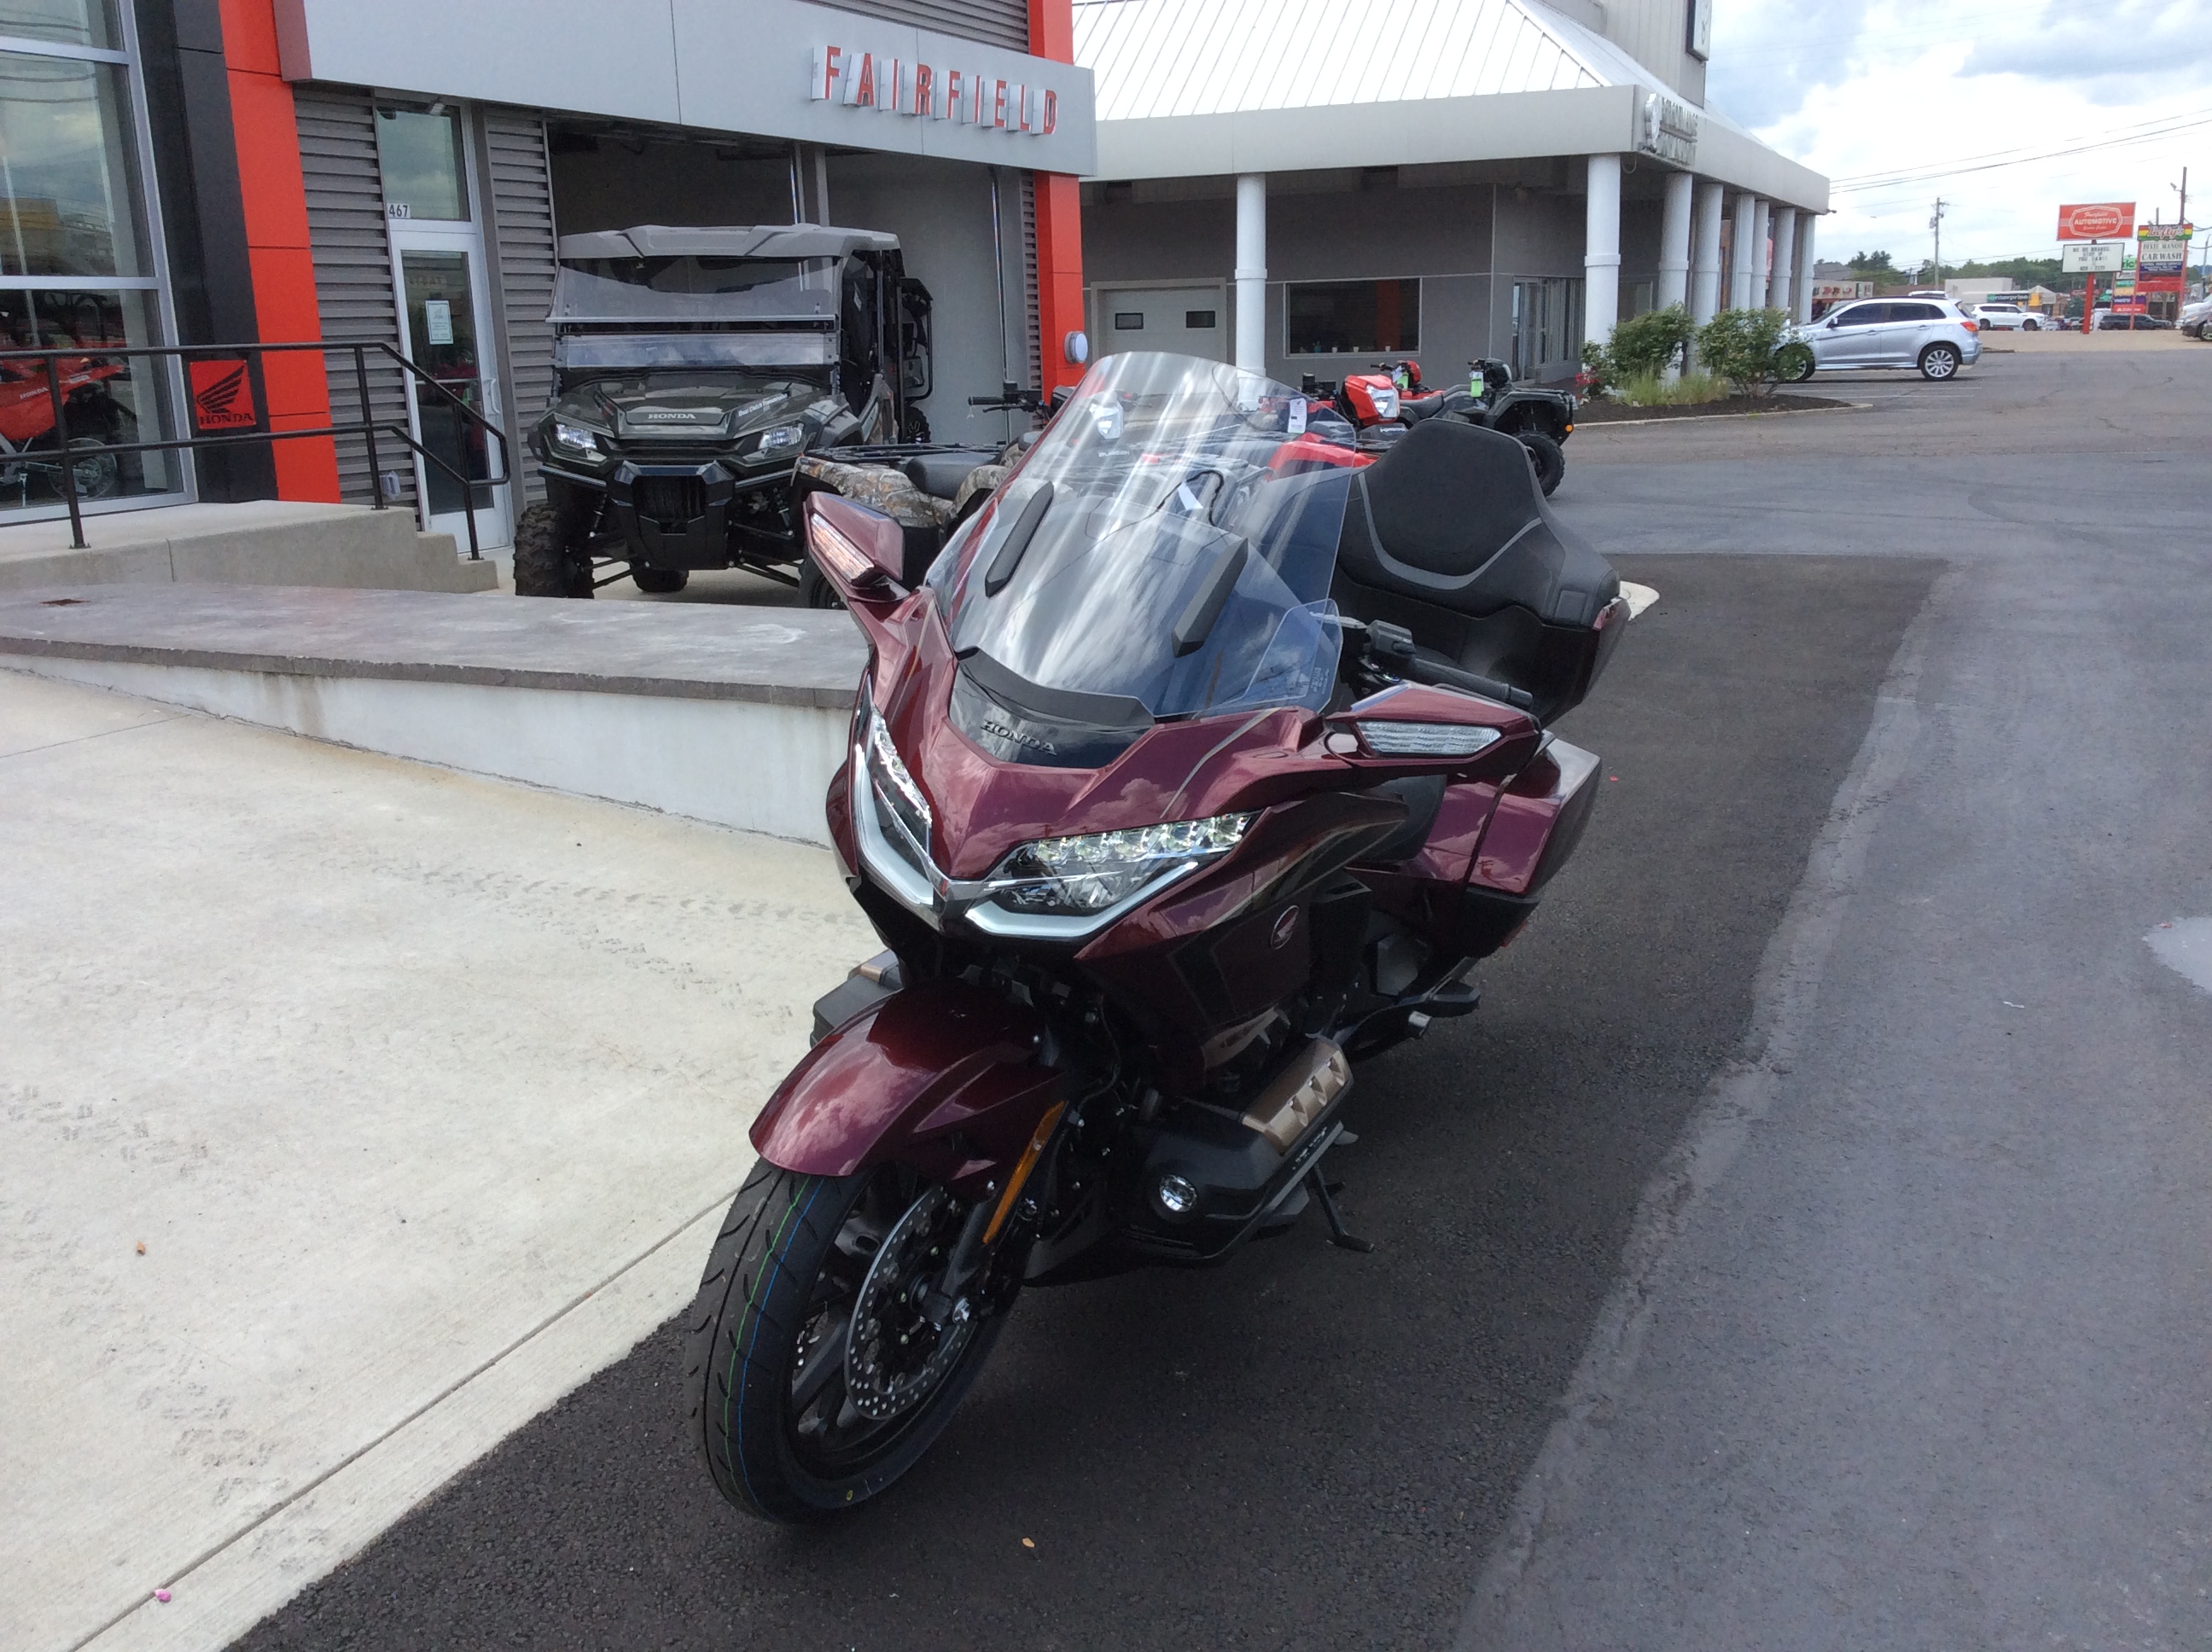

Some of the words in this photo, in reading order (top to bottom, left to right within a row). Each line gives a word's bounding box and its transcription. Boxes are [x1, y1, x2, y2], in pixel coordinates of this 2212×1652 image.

[813, 45, 1057, 135] FAIRFIELD
[389, 204, 408, 218] 467
[20, 387, 49, 399] HONDA
[200, 412, 254, 426] HONDA
[980, 721, 1057, 756] HONDA
